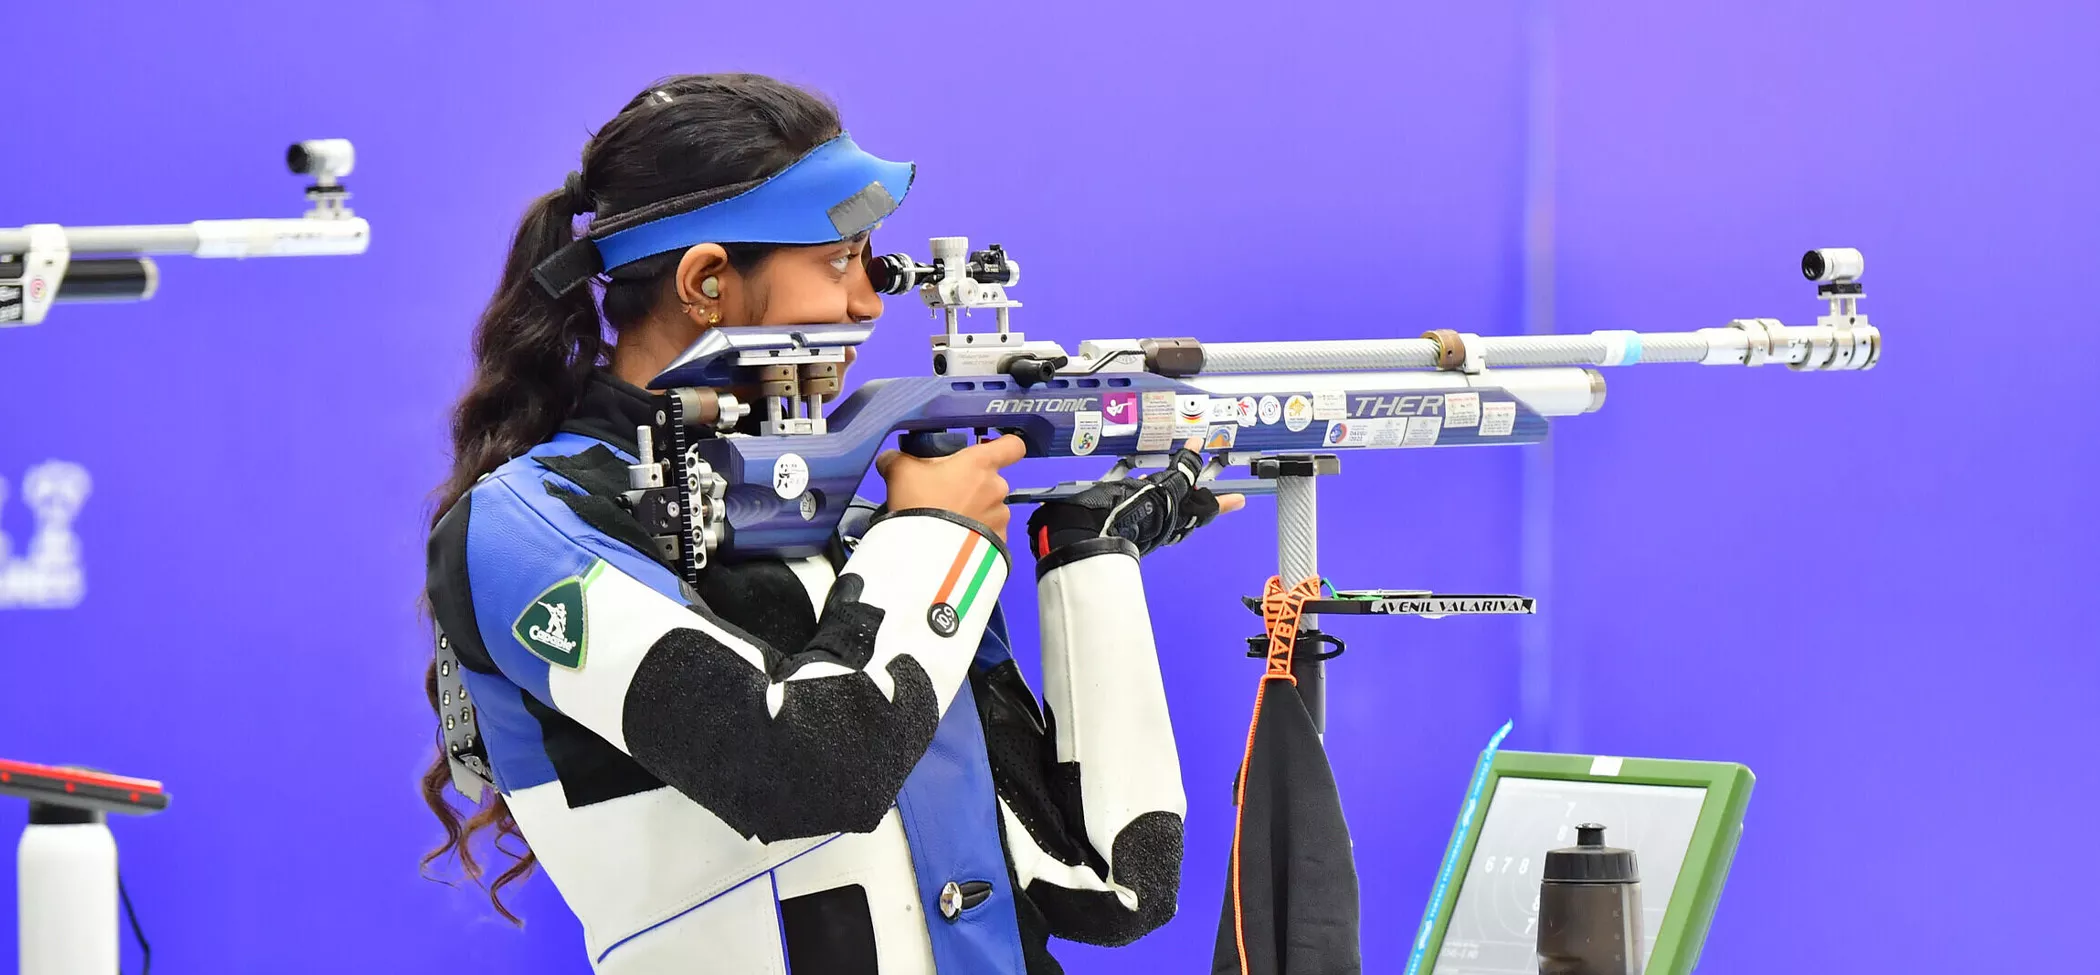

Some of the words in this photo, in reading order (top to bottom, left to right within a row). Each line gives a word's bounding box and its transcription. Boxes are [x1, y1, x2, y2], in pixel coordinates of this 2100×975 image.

[985, 398, 1098, 413] ANATOMIC
[1345, 396, 1445, 417] THER
[1377, 601, 1434, 613] AVENIL
[936, 606, 955, 629] 10.9
[1565, 802, 1577, 818] 7
[1484, 856, 1497, 874] 6
[1501, 857, 1513, 874] 7
[1518, 858, 1530, 875] 8
